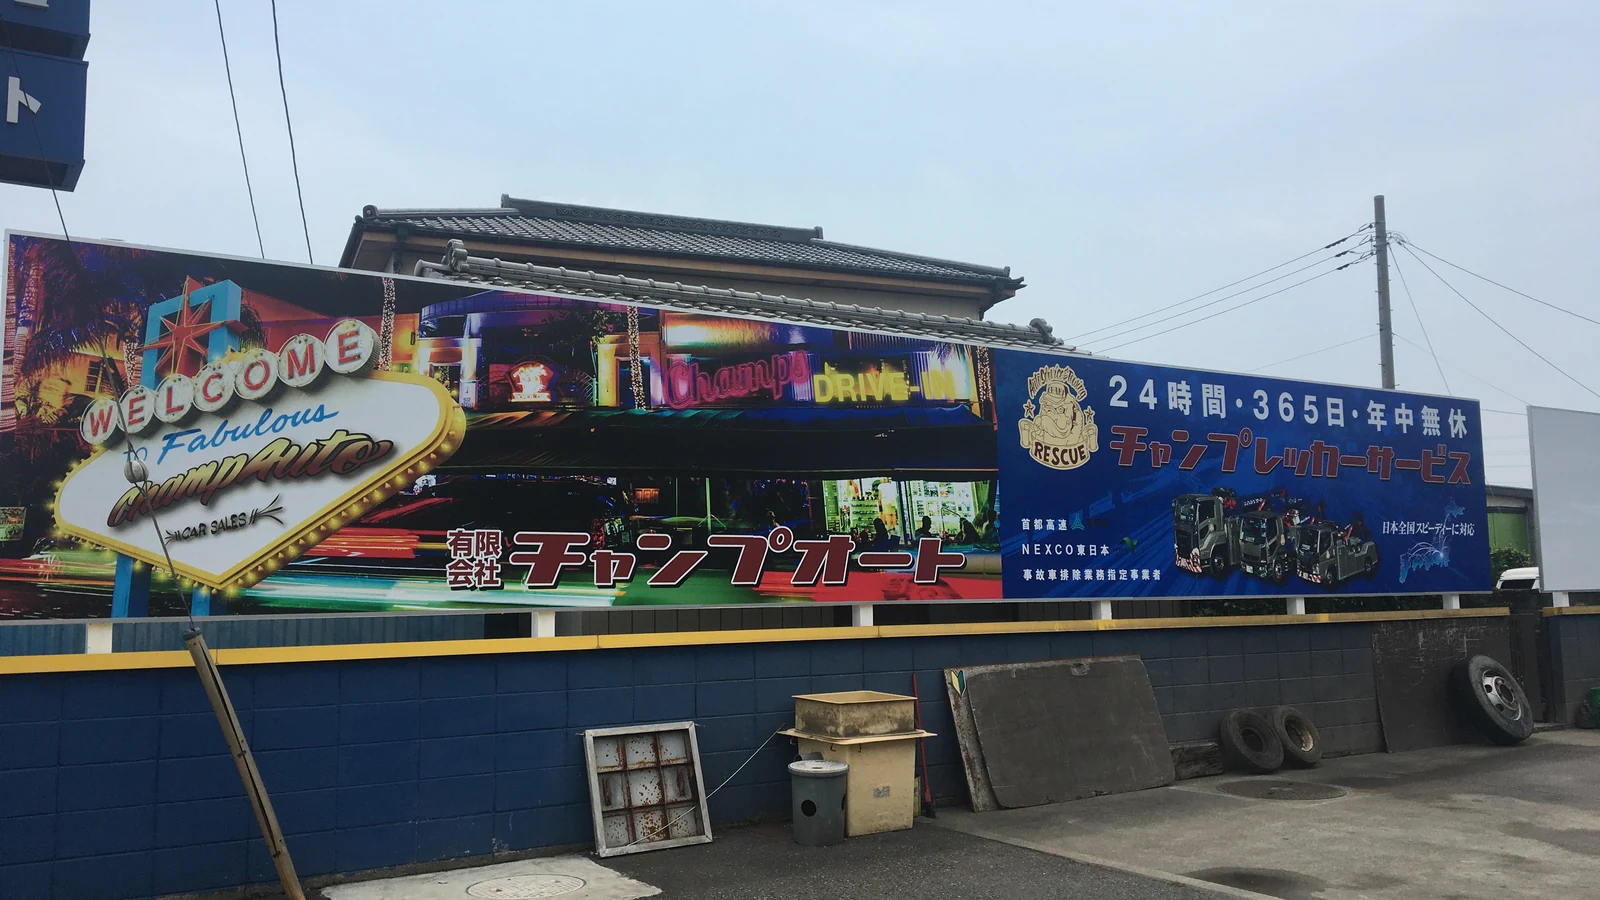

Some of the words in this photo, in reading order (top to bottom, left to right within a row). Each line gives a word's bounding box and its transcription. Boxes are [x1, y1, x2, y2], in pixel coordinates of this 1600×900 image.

[90, 327, 362, 438] WELCOME
[812, 369, 958, 403] DRIVE-IN
[157, 403, 340, 465] Fabulous
[1034, 441, 1086, 465] RESCUE
[1110, 425, 1471, 485] チャンプレッカーサービス
[181, 522, 207, 540] CAR
[210, 511, 247, 535] SALES
[1021, 518, 1068, 531] 首都高速
[1382, 520, 1475, 536] 日本全国スピーディーに対応
[447, 528, 502, 559] 有限
[509, 526, 966, 587] チャンプオート
[1022, 543, 1110, 556] NEXCO東日本
[446, 557, 503, 588] 会社
[1023, 569, 1162, 581] 事故車排除業務指定事業者
